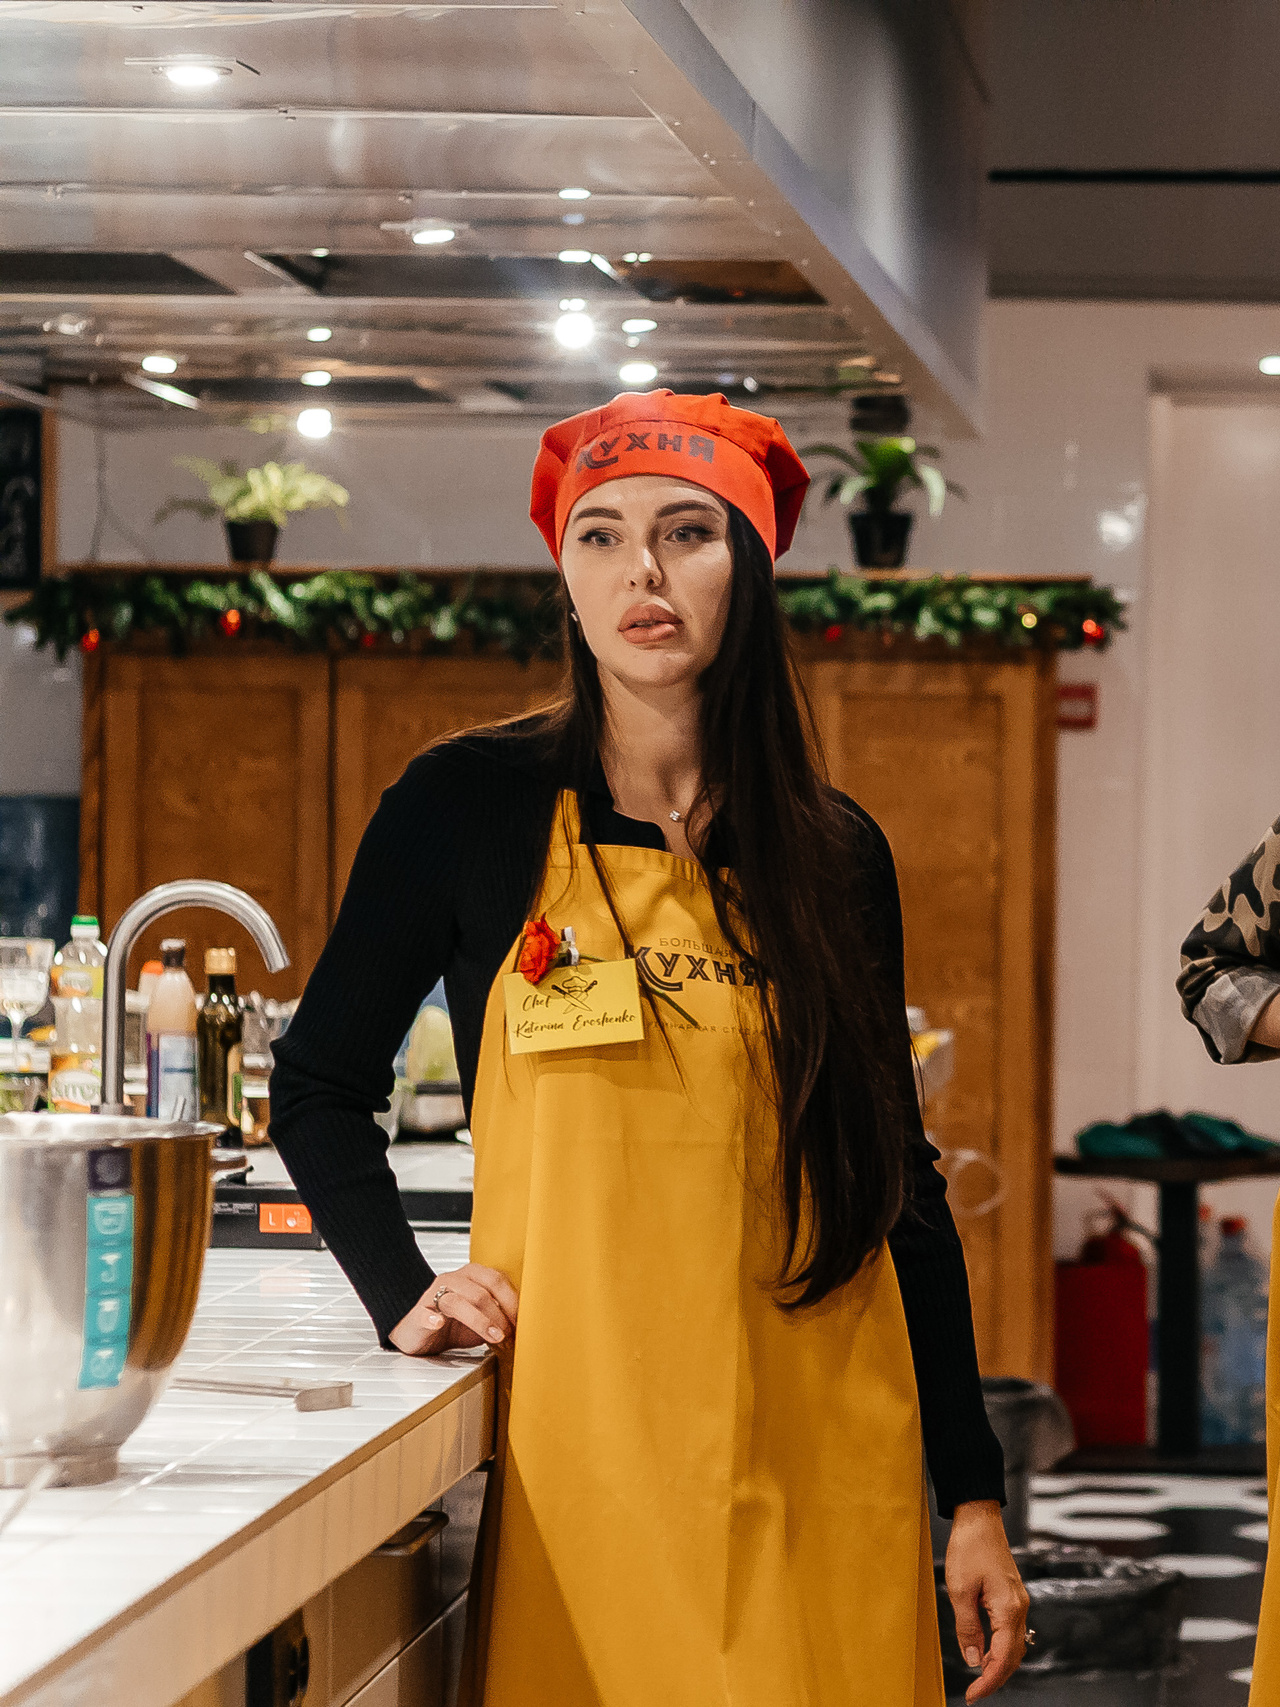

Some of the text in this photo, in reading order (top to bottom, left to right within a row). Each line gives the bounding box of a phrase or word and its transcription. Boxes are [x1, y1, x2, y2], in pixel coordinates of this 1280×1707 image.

[576, 432, 716, 474] КУХНЯ
[522, 994, 551, 1012] Chef
[513, 1009, 636, 1039] Katerina Eroshenko
